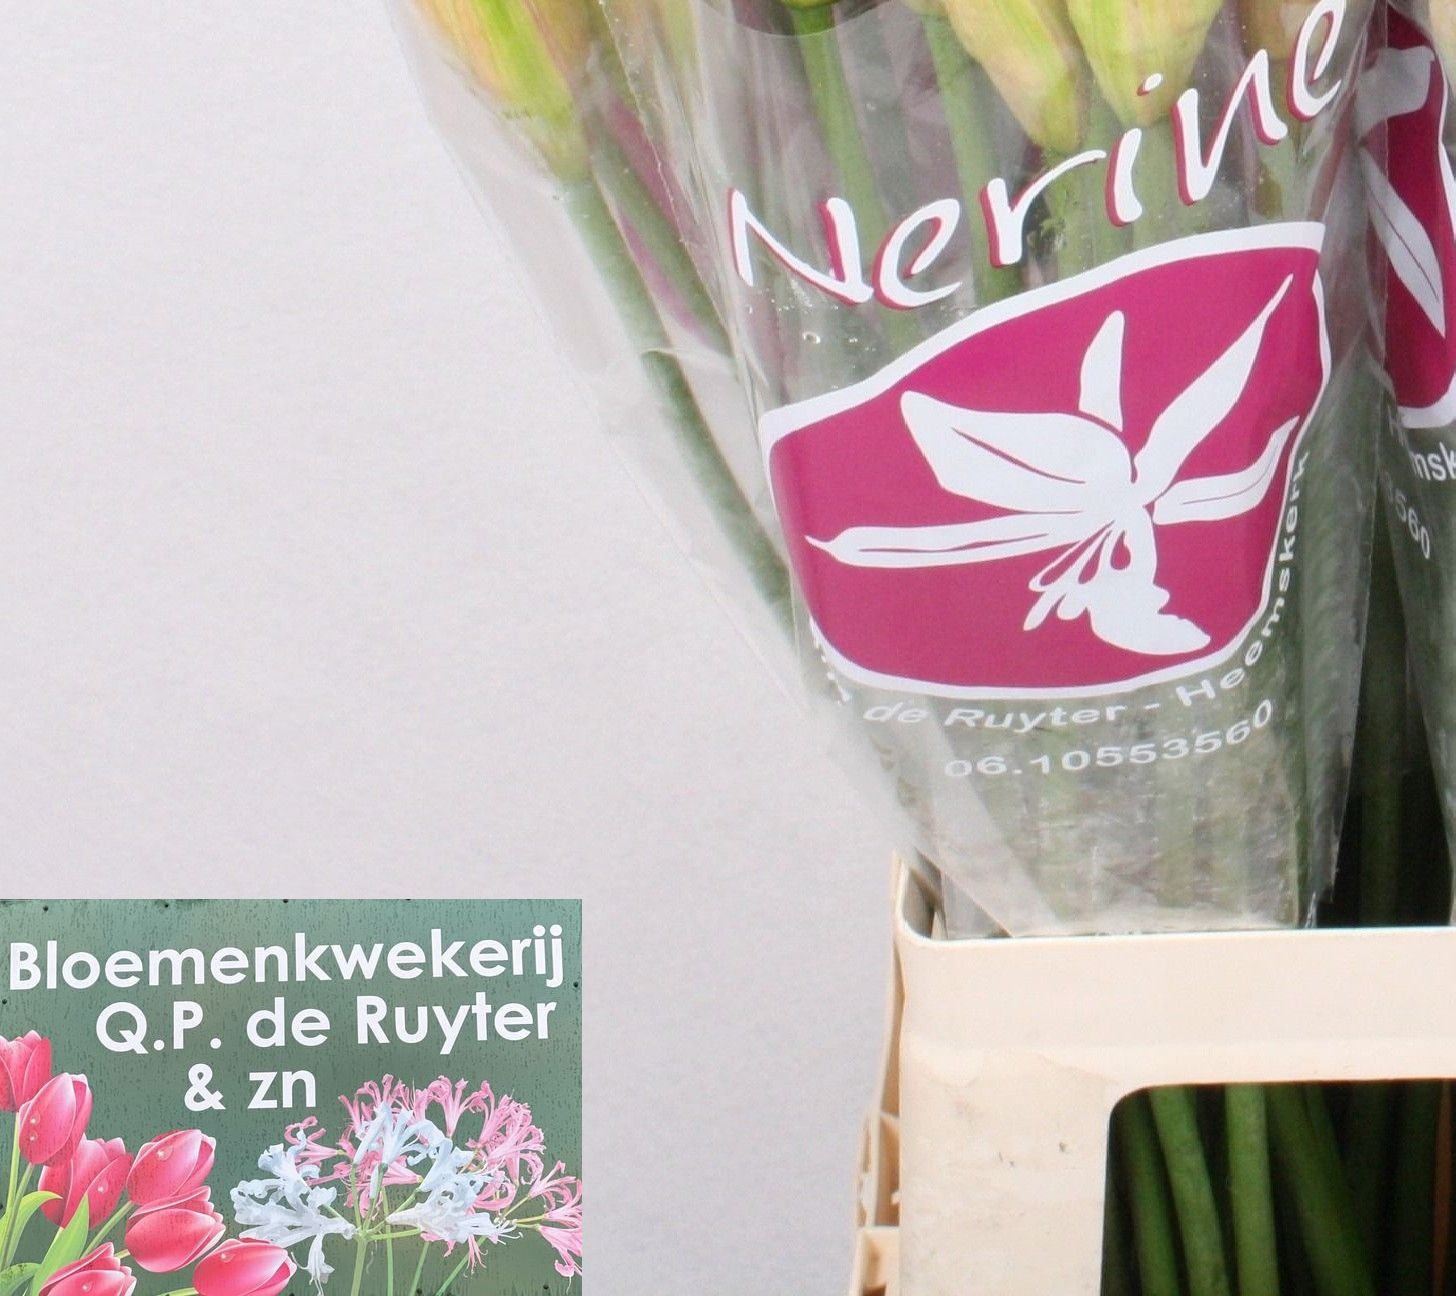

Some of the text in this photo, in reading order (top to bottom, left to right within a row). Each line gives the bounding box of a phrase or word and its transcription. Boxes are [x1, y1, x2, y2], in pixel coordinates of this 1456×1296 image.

[862, 702, 930, 724] de
[944, 703, 1126, 732] Ruyter
[1175, 450, 1311, 708] Heemskerk
[944, 699, 1274, 778] 06.10553560
